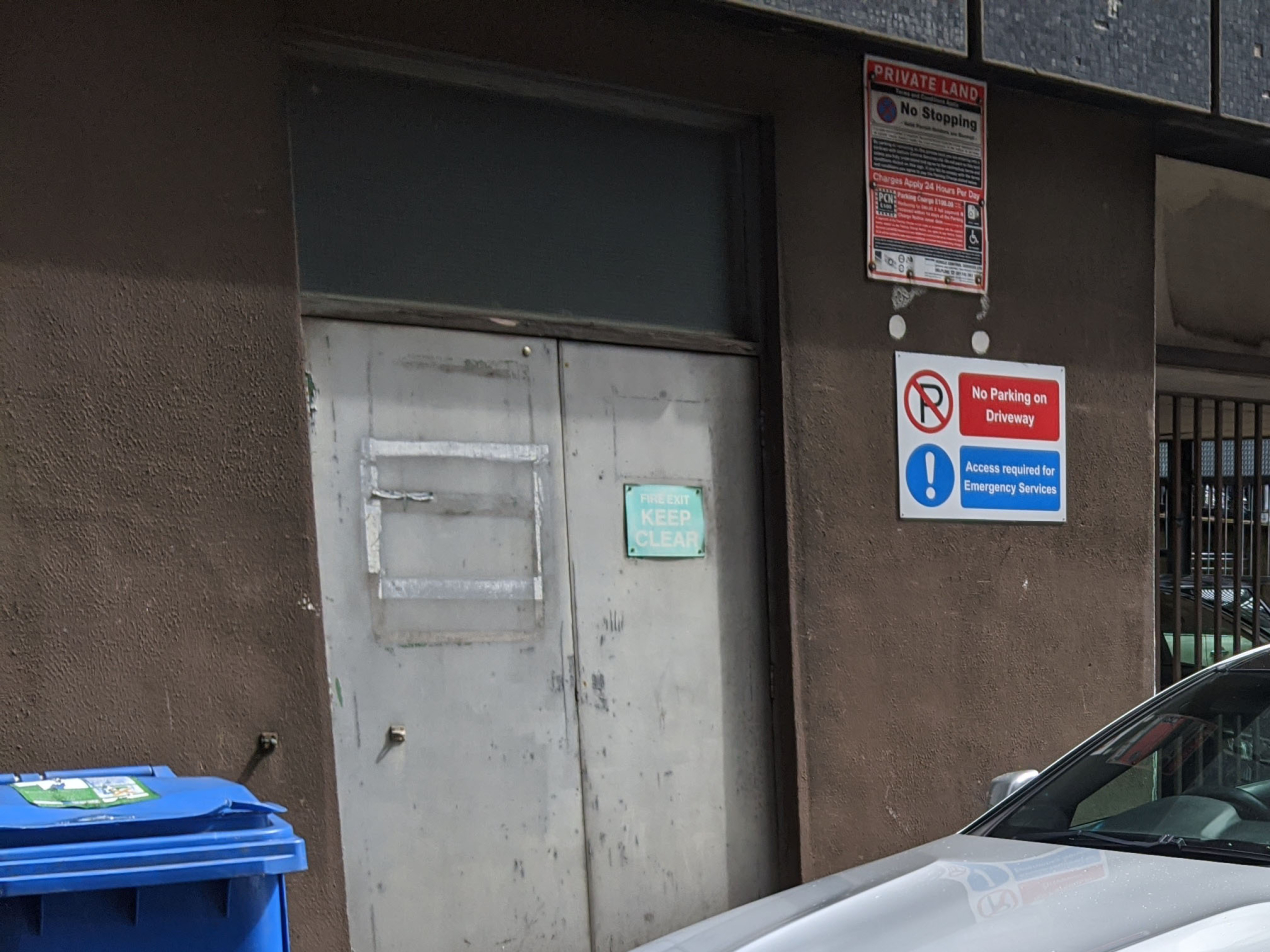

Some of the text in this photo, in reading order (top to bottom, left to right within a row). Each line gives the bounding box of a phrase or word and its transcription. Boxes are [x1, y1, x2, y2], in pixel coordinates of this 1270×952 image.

[874, 65, 979, 100] PRIVATE LAND
[901, 101, 977, 132] No Stopping
[872, 172, 980, 201] Charges Apply 24 Hours Per Day
[878, 192, 894, 203] PCN
[972, 386, 1047, 405] No Parking on
[986, 409, 1035, 427] Driveway
[965, 461, 1055, 477] Access required for
[964, 480, 1057, 495] Emergency Services
[640, 494, 690, 505] FIRE EXIT
[641, 508, 691, 526] KEEP
[635, 530, 699, 548] CLEAR
